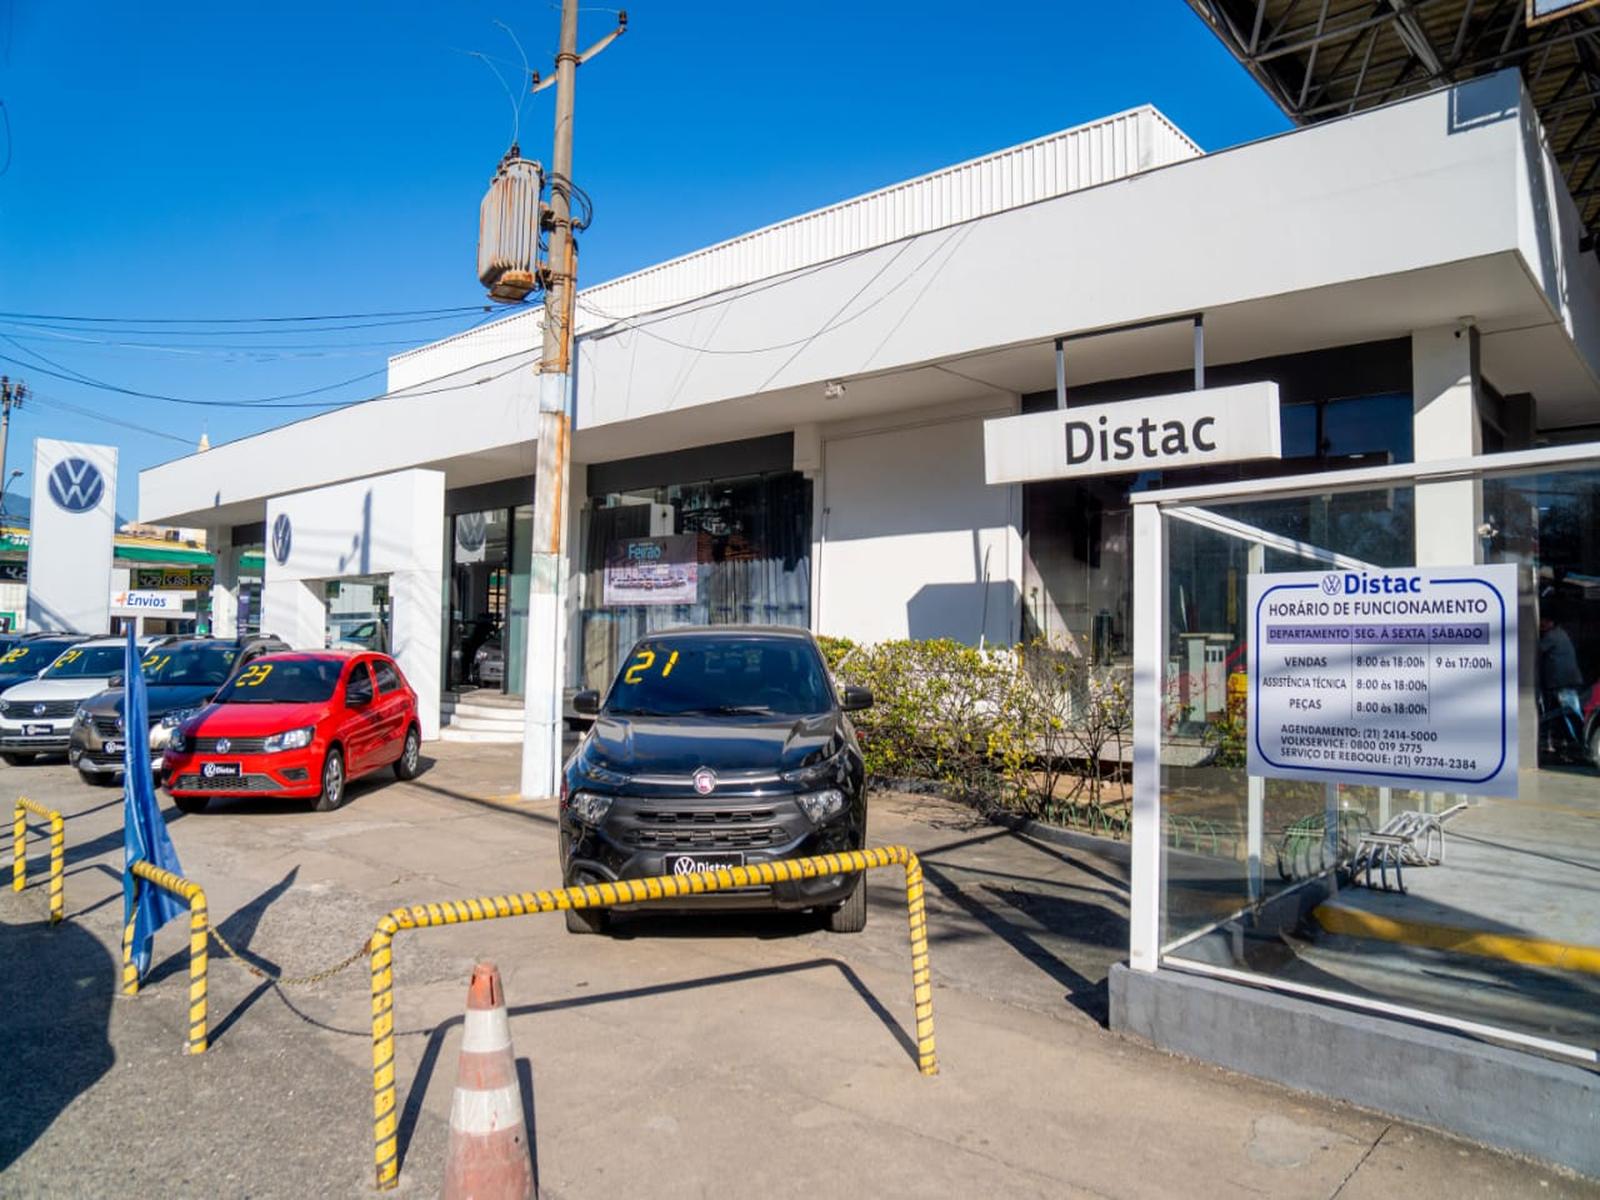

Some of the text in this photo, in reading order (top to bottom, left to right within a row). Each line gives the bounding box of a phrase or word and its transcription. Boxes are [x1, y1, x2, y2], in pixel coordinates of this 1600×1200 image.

[1065, 415, 1217, 465] Distac
[1345, 573, 1421, 595] Distac
[1269, 599, 1488, 616] HORÁRIO DE FUNCIONAMENTO
[1269, 628, 1350, 639] DEPARTAMENTO
[1356, 628, 1378, 639] SEG.
[1392, 627, 1426, 639] SEXTA
[1432, 625, 1483, 639] SÁBADO
[624, 650, 679, 684] 21
[1284, 656, 1328, 668] VENDAS
[1356, 655, 1378, 668] 8:00
[1393, 655, 1425, 668] 18:00h
[1436, 656, 1443, 669] 9
[1459, 657, 1493, 669] 17:00h
[235, 664, 274, 687] 23
[1262, 675, 1311, 688] ASSISTÊNCIA
[1312, 676, 1347, 689] TÉCNICA
[1356, 679, 1379, 690] 8:00
[1394, 680, 1427, 692] 18:00h
[1289, 698, 1322, 711] PEÇAS
[1356, 702, 1379, 713] 8:00
[1394, 702, 1427, 715] 18:00h
[1281, 724, 1438, 742] AGENDAMENTO: (21) 2414-5000
[1280, 736, 1423, 754] VOLKSERVICE: 0800 019 5775
[1280, 747, 1477, 770] SERVIÇO DE REBOQUE: (21) 97374-2384
